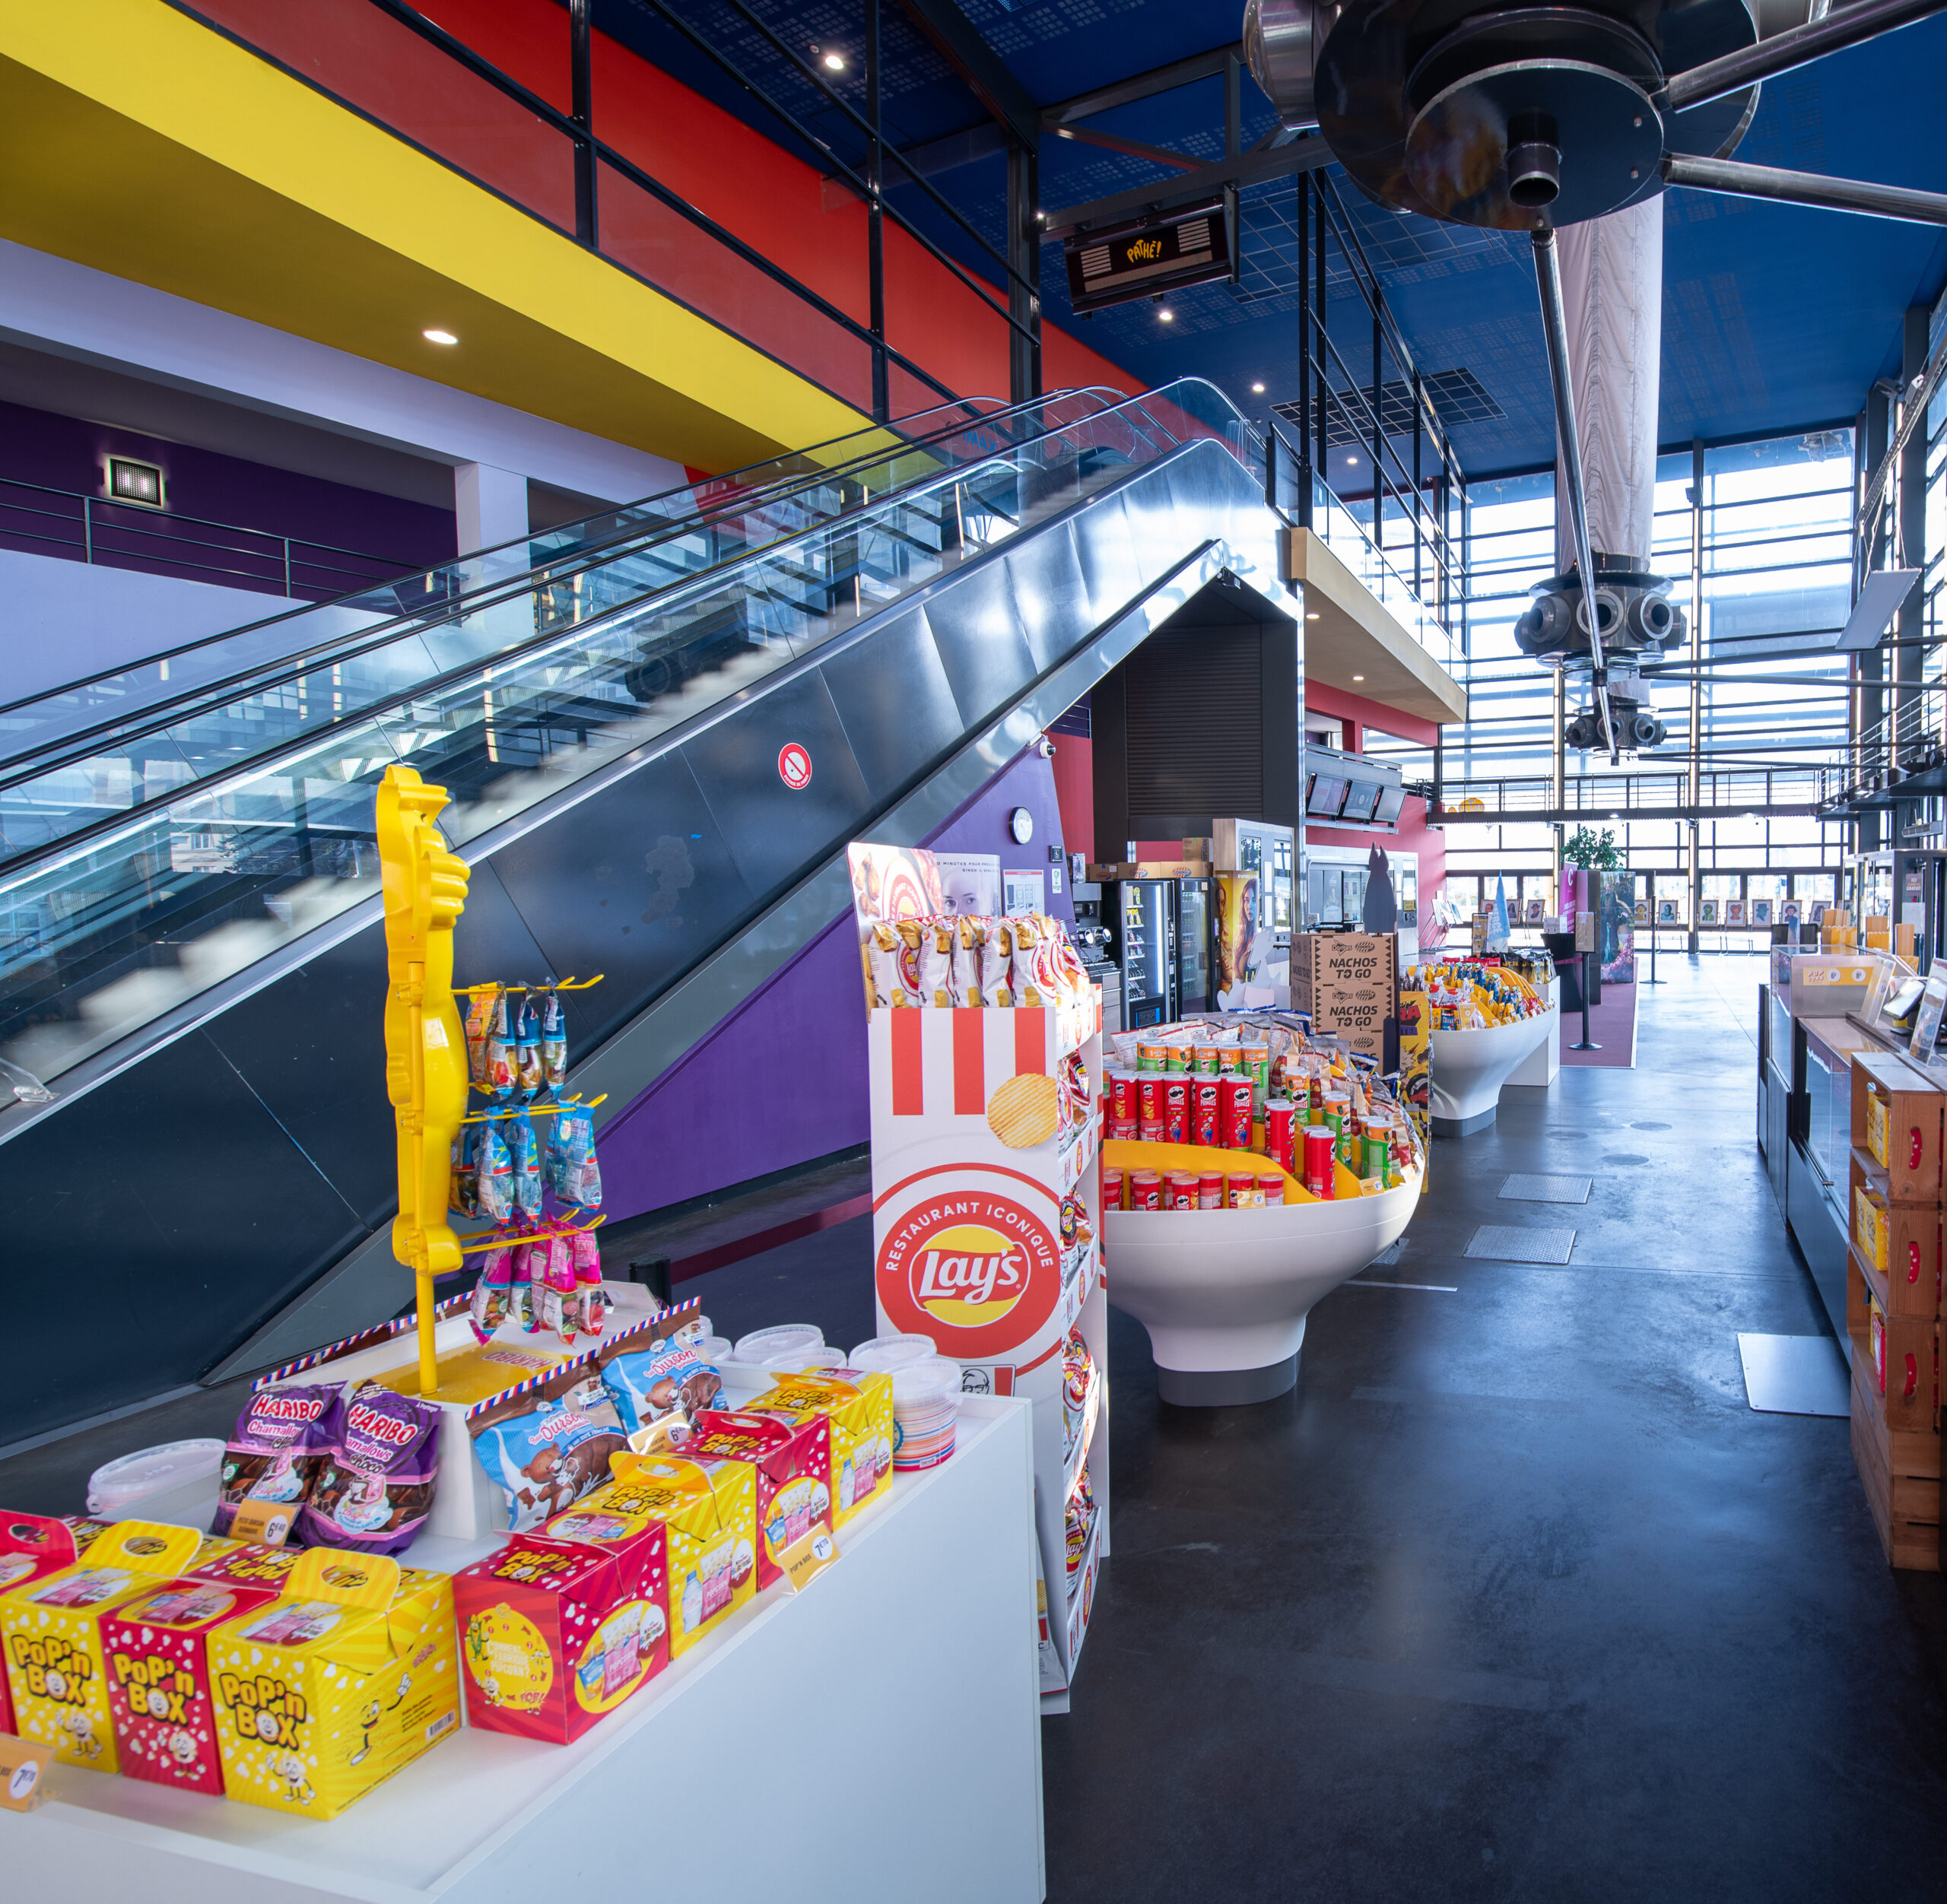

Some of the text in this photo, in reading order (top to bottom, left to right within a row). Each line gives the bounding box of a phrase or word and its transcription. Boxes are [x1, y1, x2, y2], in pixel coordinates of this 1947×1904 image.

[1126, 239, 1162, 263] PATHÉ!
[963, 431, 997, 453] IMAX
[1329, 957, 1378, 968] NACHOS
[1336, 969, 1371, 979] TO GO
[1329, 1006, 1378, 1016] NACHOS
[1336, 1017, 1371, 1027] TO GO
[885, 1202, 1054, 1271] RESTAURANT ICONIQUE
[918, 1249, 1022, 1306] Lay's
[482, 1350, 557, 1370] HARIBO
[652, 1350, 697, 1375] Ourson
[251, 1395, 324, 1420] HARIBO
[774, 1396, 816, 1411] BOX
[247, 1420, 302, 1438] Chamallo
[348, 1403, 419, 1445] HARIBO
[541, 1412, 588, 1441] Ourson
[345, 1435, 394, 1462] amallows
[697, 1440, 745, 1457] BOX
[602, 1496, 656, 1515] BOX
[267, 1522, 287, 1537] 6€40
[815, 1537, 830, 1557] 7€70
[802, 1553, 812, 1564] BOX
[491, 1563, 550, 1585] BOX
[26, 1663, 86, 1706] BOX
[126, 1680, 189, 1727] BOX
[520, 1691, 546, 1705] POP!
[234, 1702, 300, 1751] BOX
